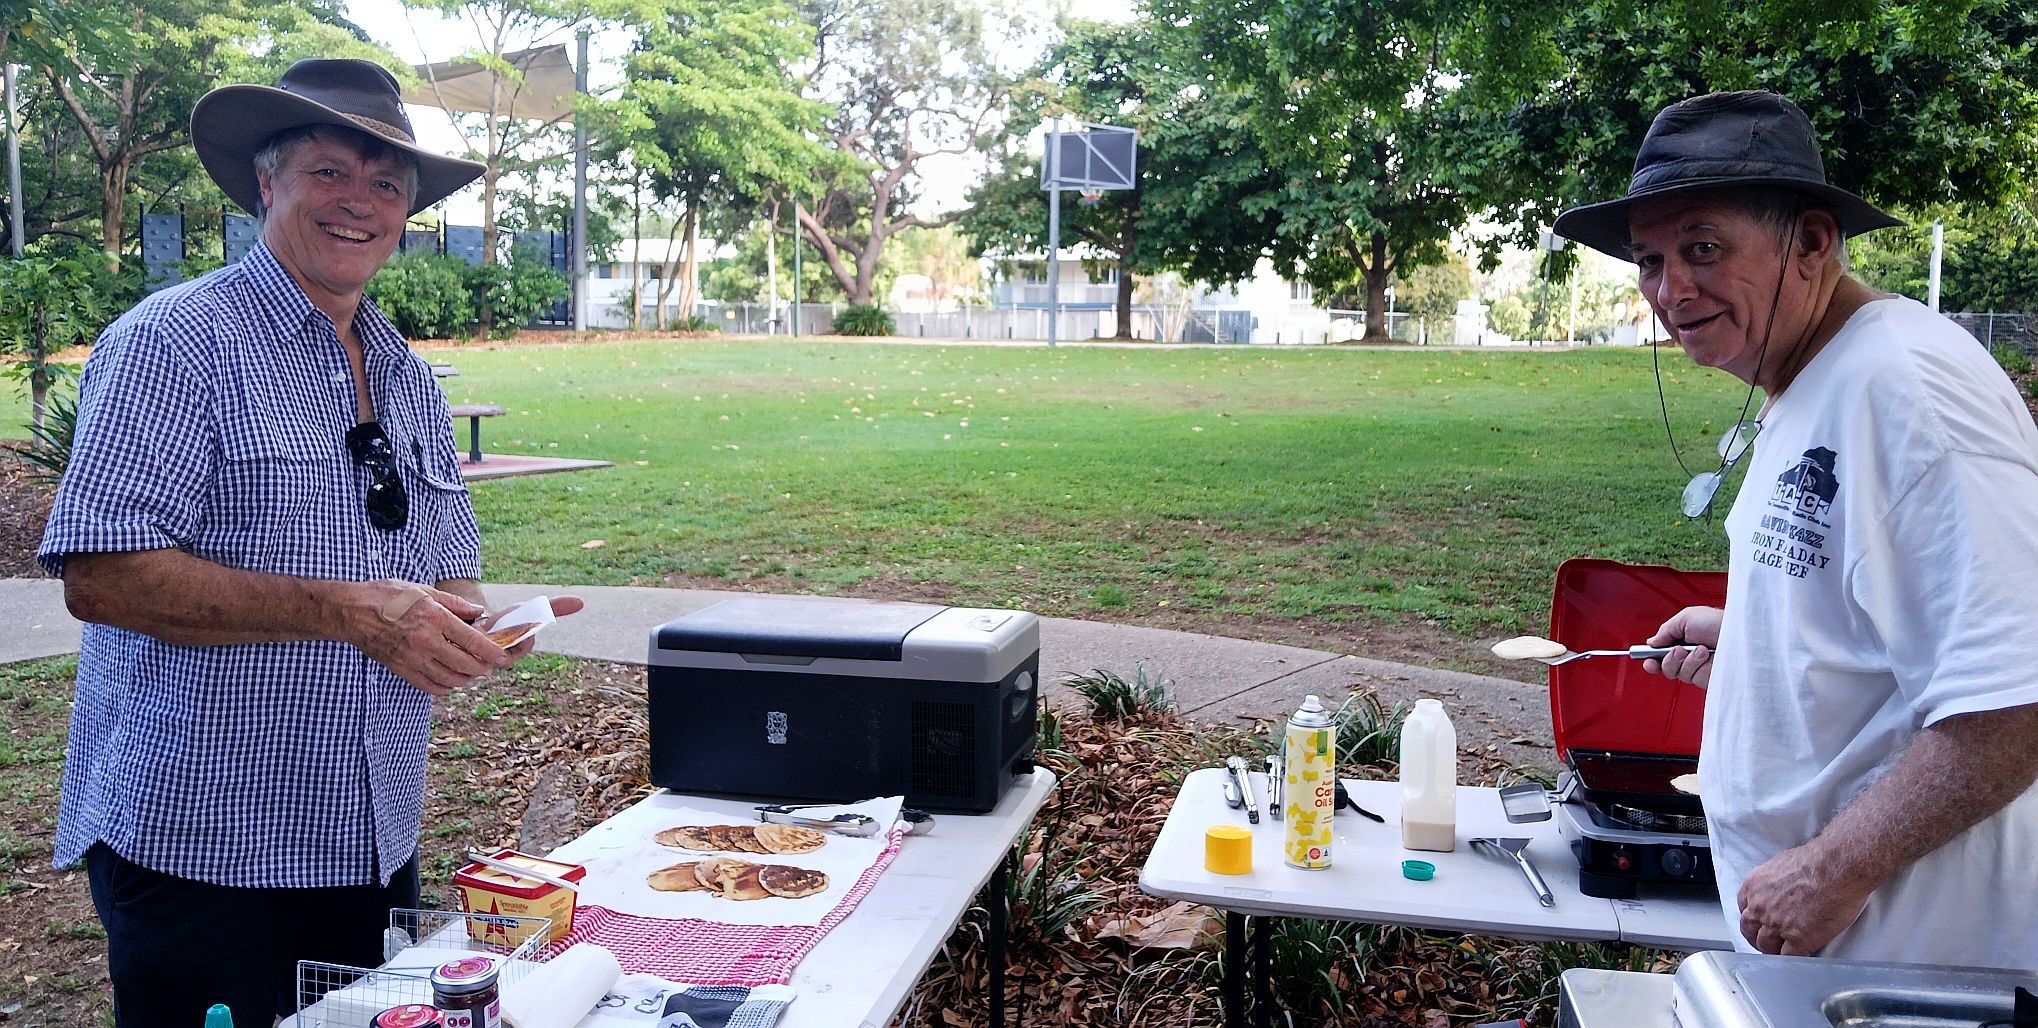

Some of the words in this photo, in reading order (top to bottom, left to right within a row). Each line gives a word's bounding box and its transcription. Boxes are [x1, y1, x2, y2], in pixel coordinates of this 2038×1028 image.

[1751, 531, 1775, 549] IRON
[1753, 549, 1783, 569] CAGE
[1315, 798, 1328, 808] Oil
